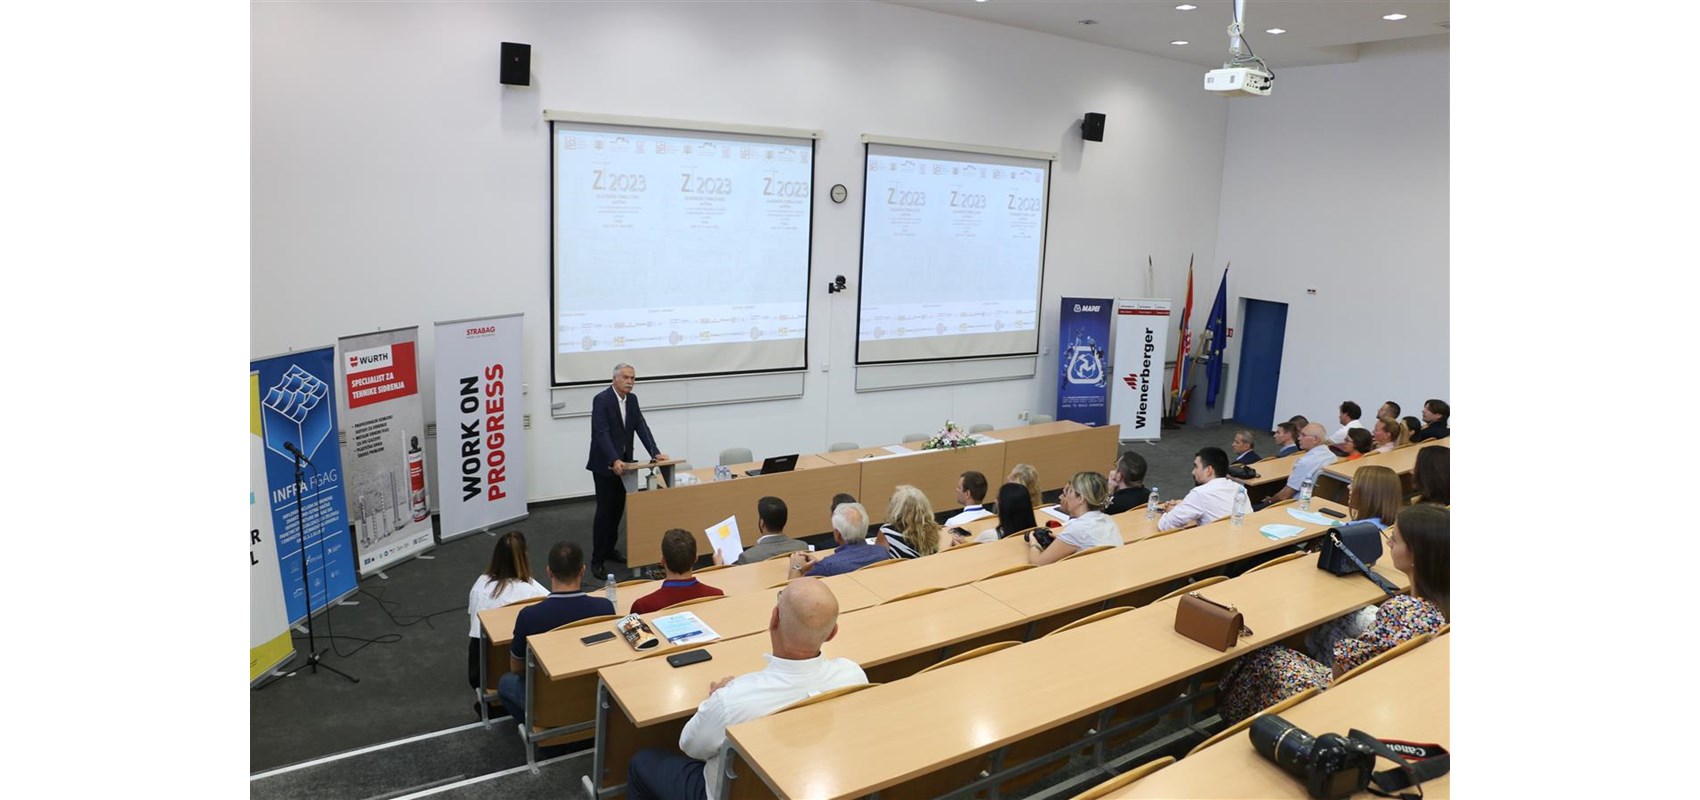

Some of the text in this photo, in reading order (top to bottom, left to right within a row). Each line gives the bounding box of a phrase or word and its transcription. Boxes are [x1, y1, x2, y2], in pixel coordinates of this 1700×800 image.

[608, 173, 647, 193] 2023
[696, 177, 732, 195] 2023
[776, 181, 809, 198] 2023
[899, 191, 926, 207] 2023
[961, 193, 987, 209] 2023
[1017, 197, 1041, 212] 2023
[466, 326, 496, 336] STRABAG
[360, 353, 389, 365] WÜRTH
[352, 372, 394, 388] SPECIJALIST ZA
[1135, 327, 1154, 429] Wienerberger
[352, 381, 405, 399] TEHNIKE SIDRENJA
[460, 376, 482, 502] WORK ON
[485, 363, 506, 502] PROGRESS
[309, 469, 337, 489] FGAG
[1386, 744, 1426, 757] Canon
